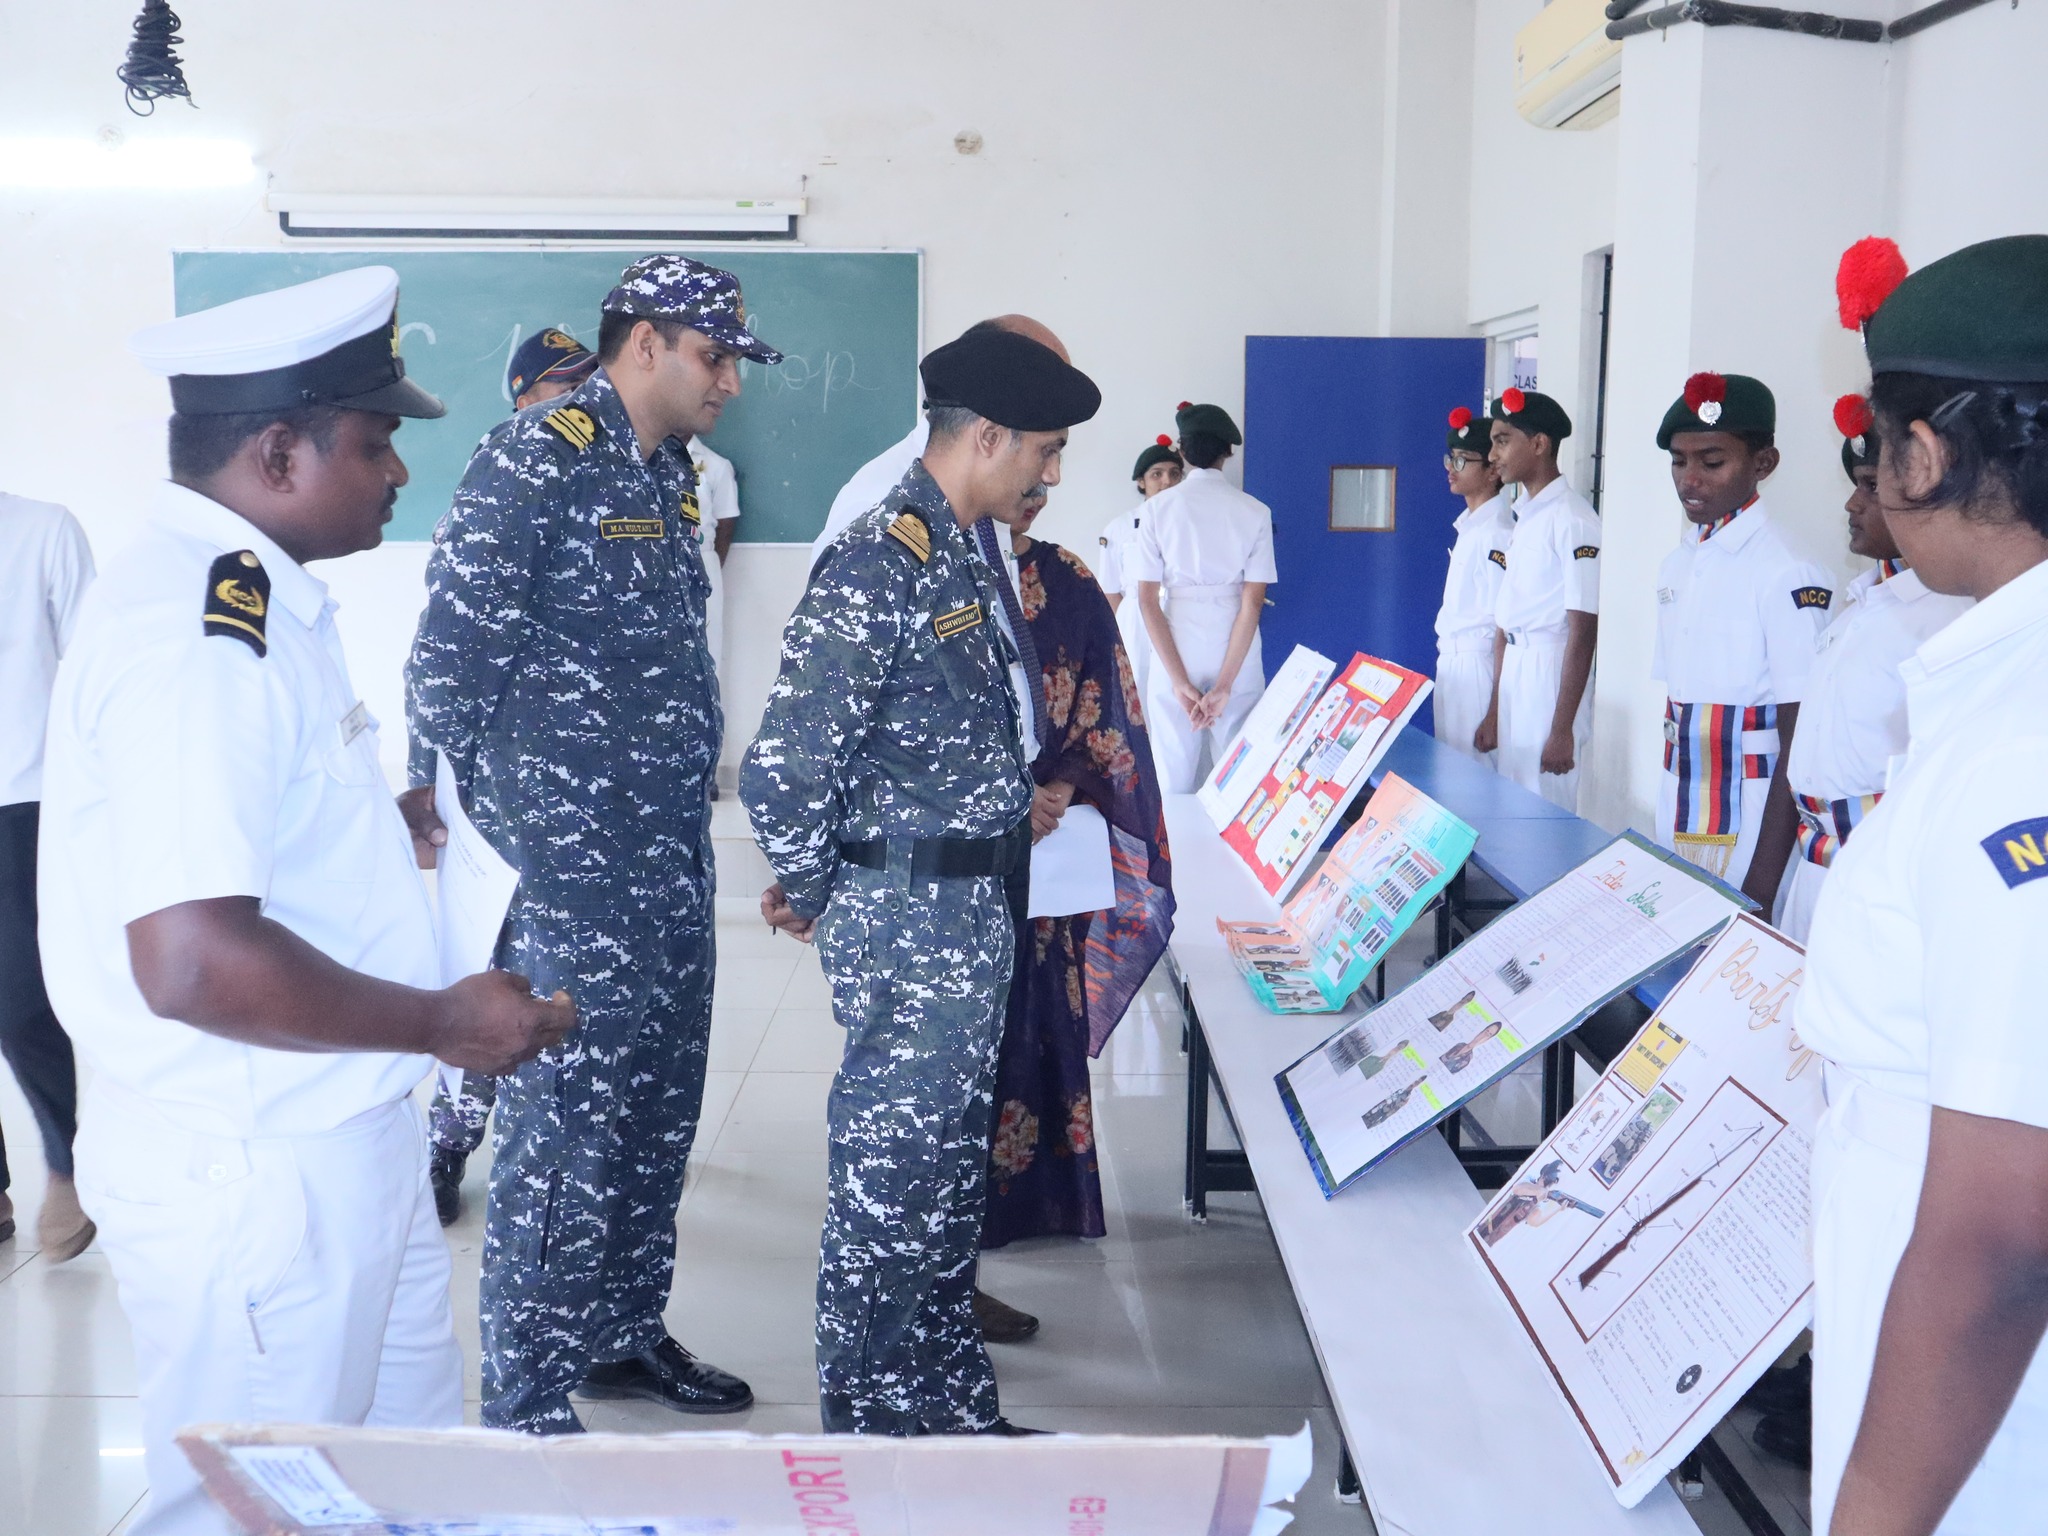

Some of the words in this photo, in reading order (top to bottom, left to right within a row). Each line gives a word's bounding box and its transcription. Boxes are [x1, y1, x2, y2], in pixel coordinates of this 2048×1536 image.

[1576, 547, 1596, 558] NCC
[1800, 589, 1827, 605] NCC
[2004, 831, 2048, 872] N
[781, 1450, 860, 1536] XPORT
